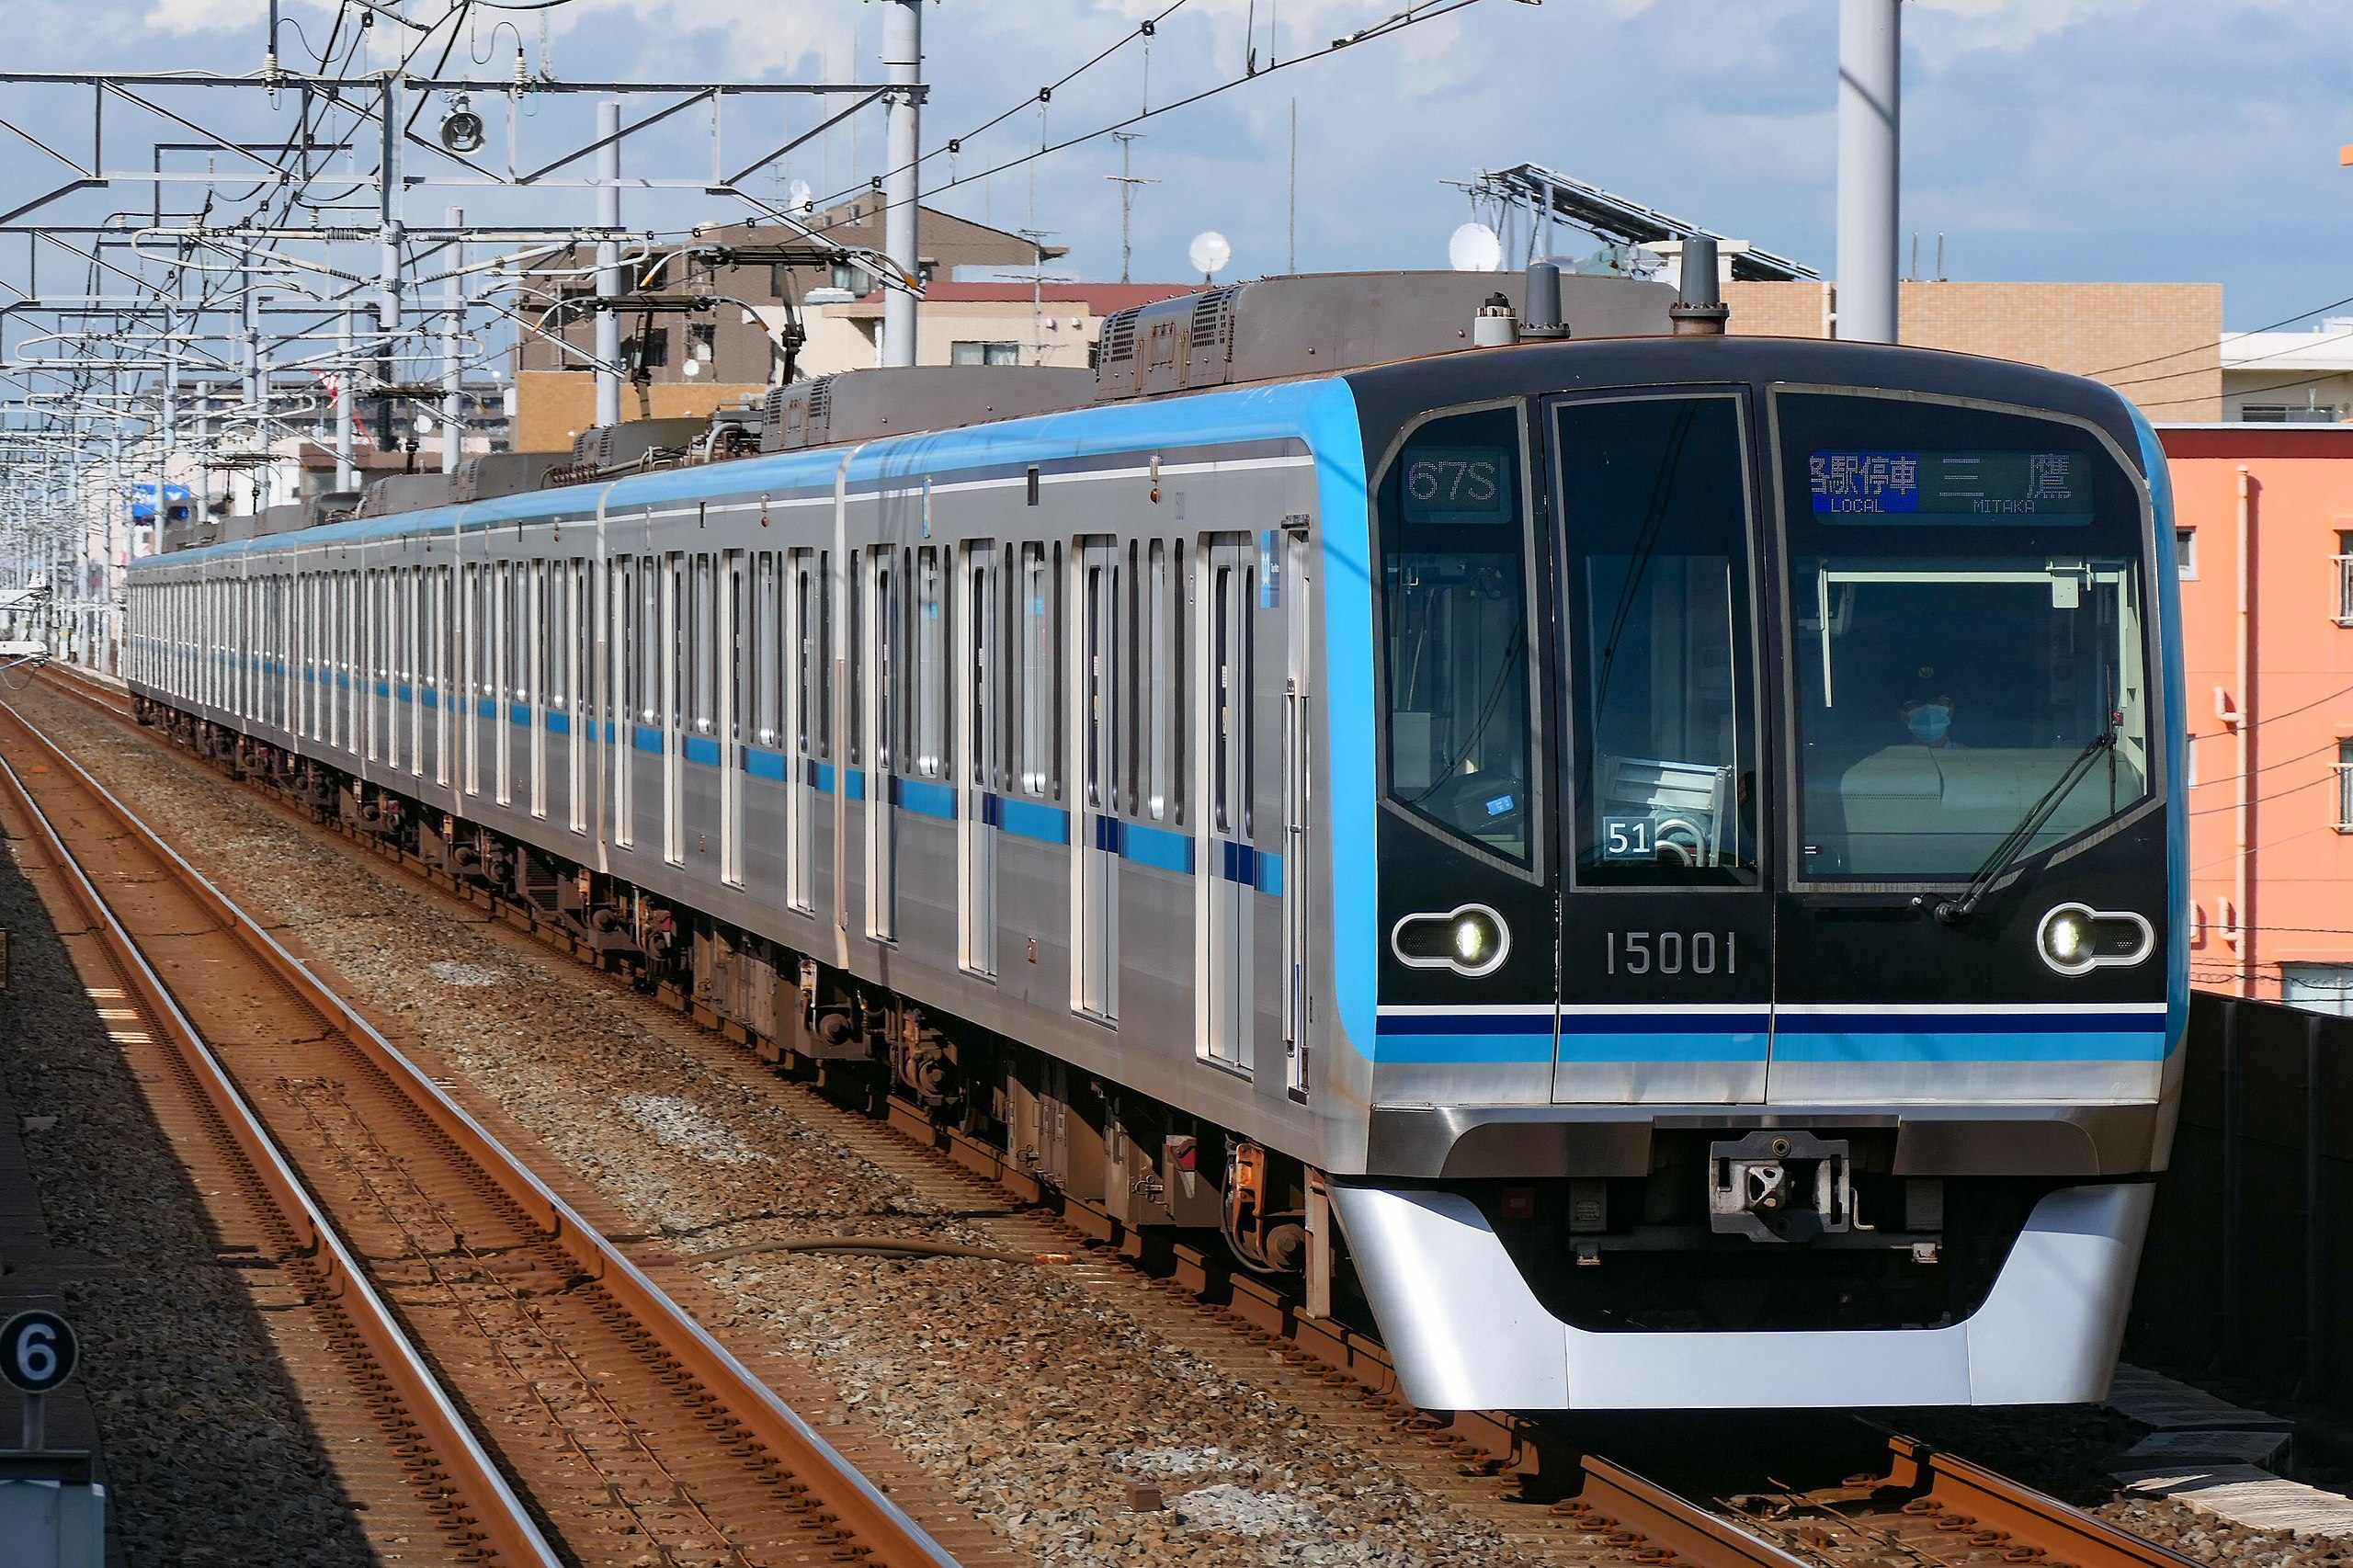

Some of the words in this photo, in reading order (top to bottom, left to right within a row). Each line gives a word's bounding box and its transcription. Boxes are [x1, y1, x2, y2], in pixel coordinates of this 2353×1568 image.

[1408, 461, 1496, 500] 67S
[1831, 498, 1885, 513] LOCAL
[1973, 499, 2035, 514] MITAKA
[1608, 823, 1651, 854] 51
[1608, 931, 1735, 974] 15001
[17, 1323, 57, 1381] 6
